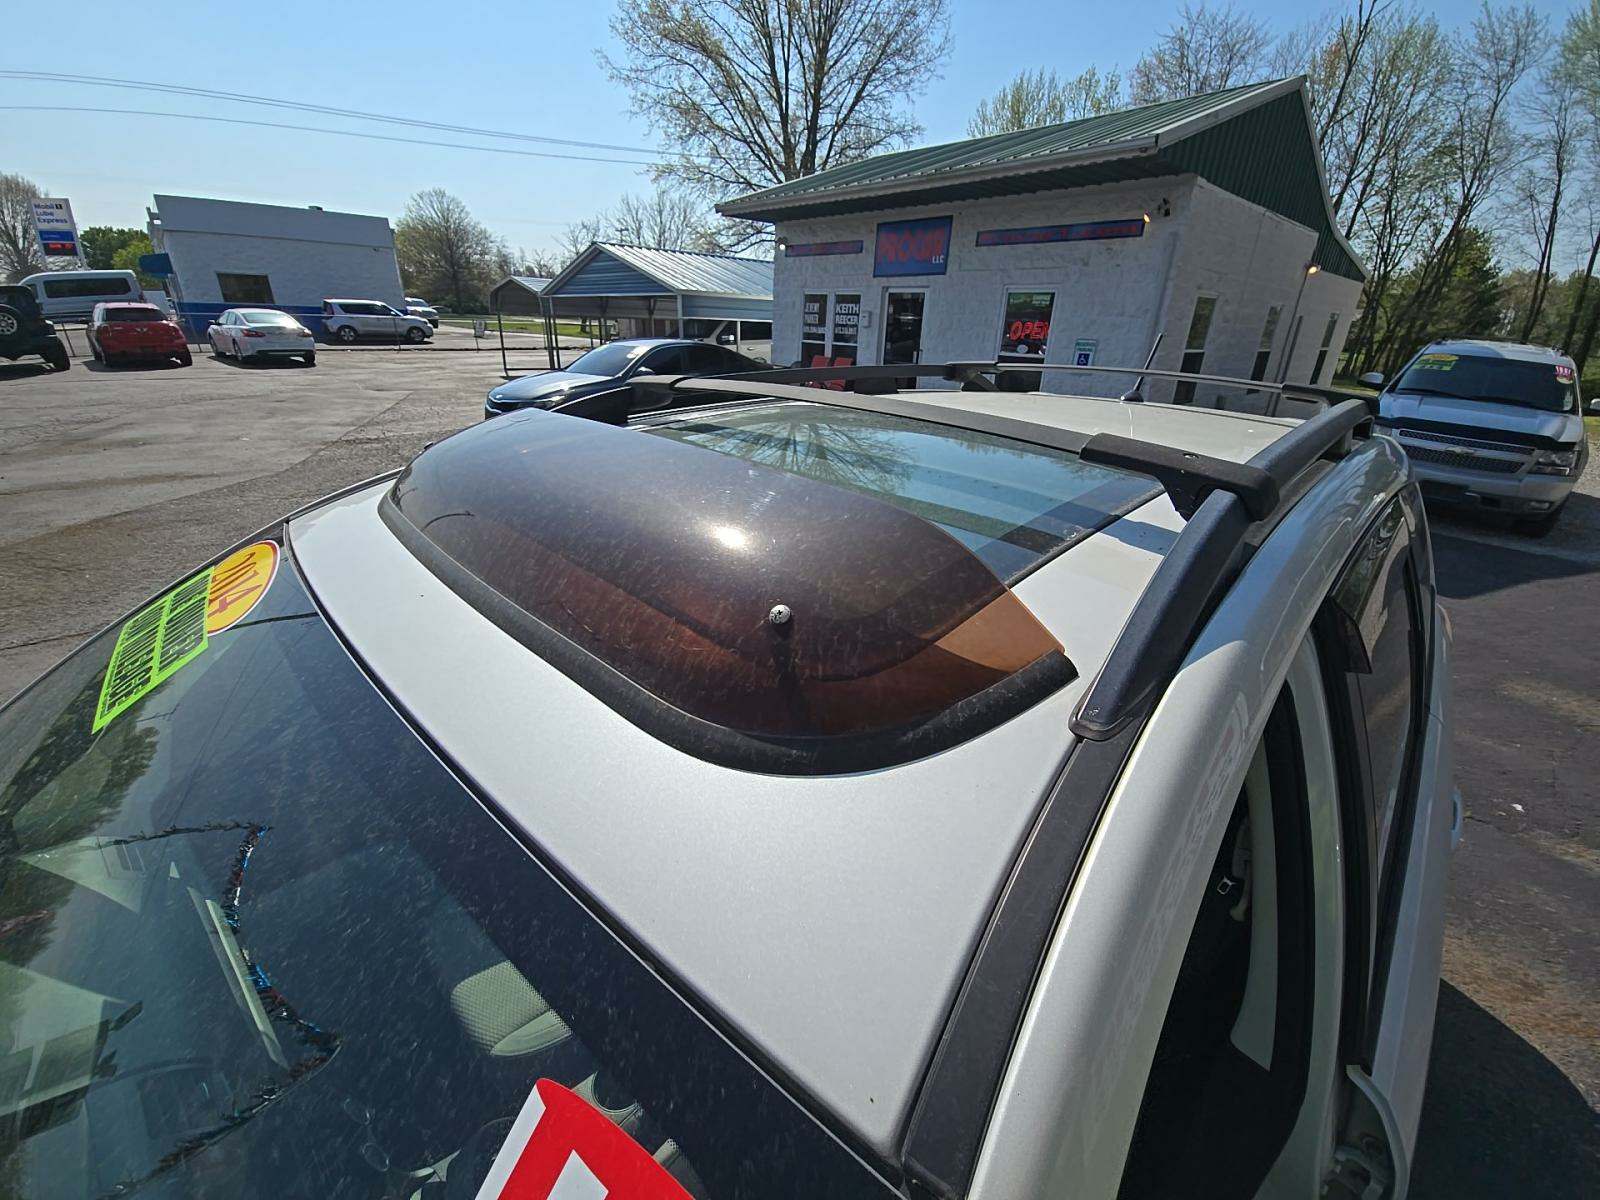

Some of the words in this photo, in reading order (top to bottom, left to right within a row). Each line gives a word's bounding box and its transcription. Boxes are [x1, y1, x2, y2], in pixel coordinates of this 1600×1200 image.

[931, 255, 945, 264] LLC
[836, 303, 859, 314] KEITH
[1010, 320, 1050, 341] OPEN
[171, 573, 208, 613] ONE
[207, 552, 263, 619] 2014
[157, 595, 207, 673] OWNER
[102, 624, 160, 716] MILEAGE
